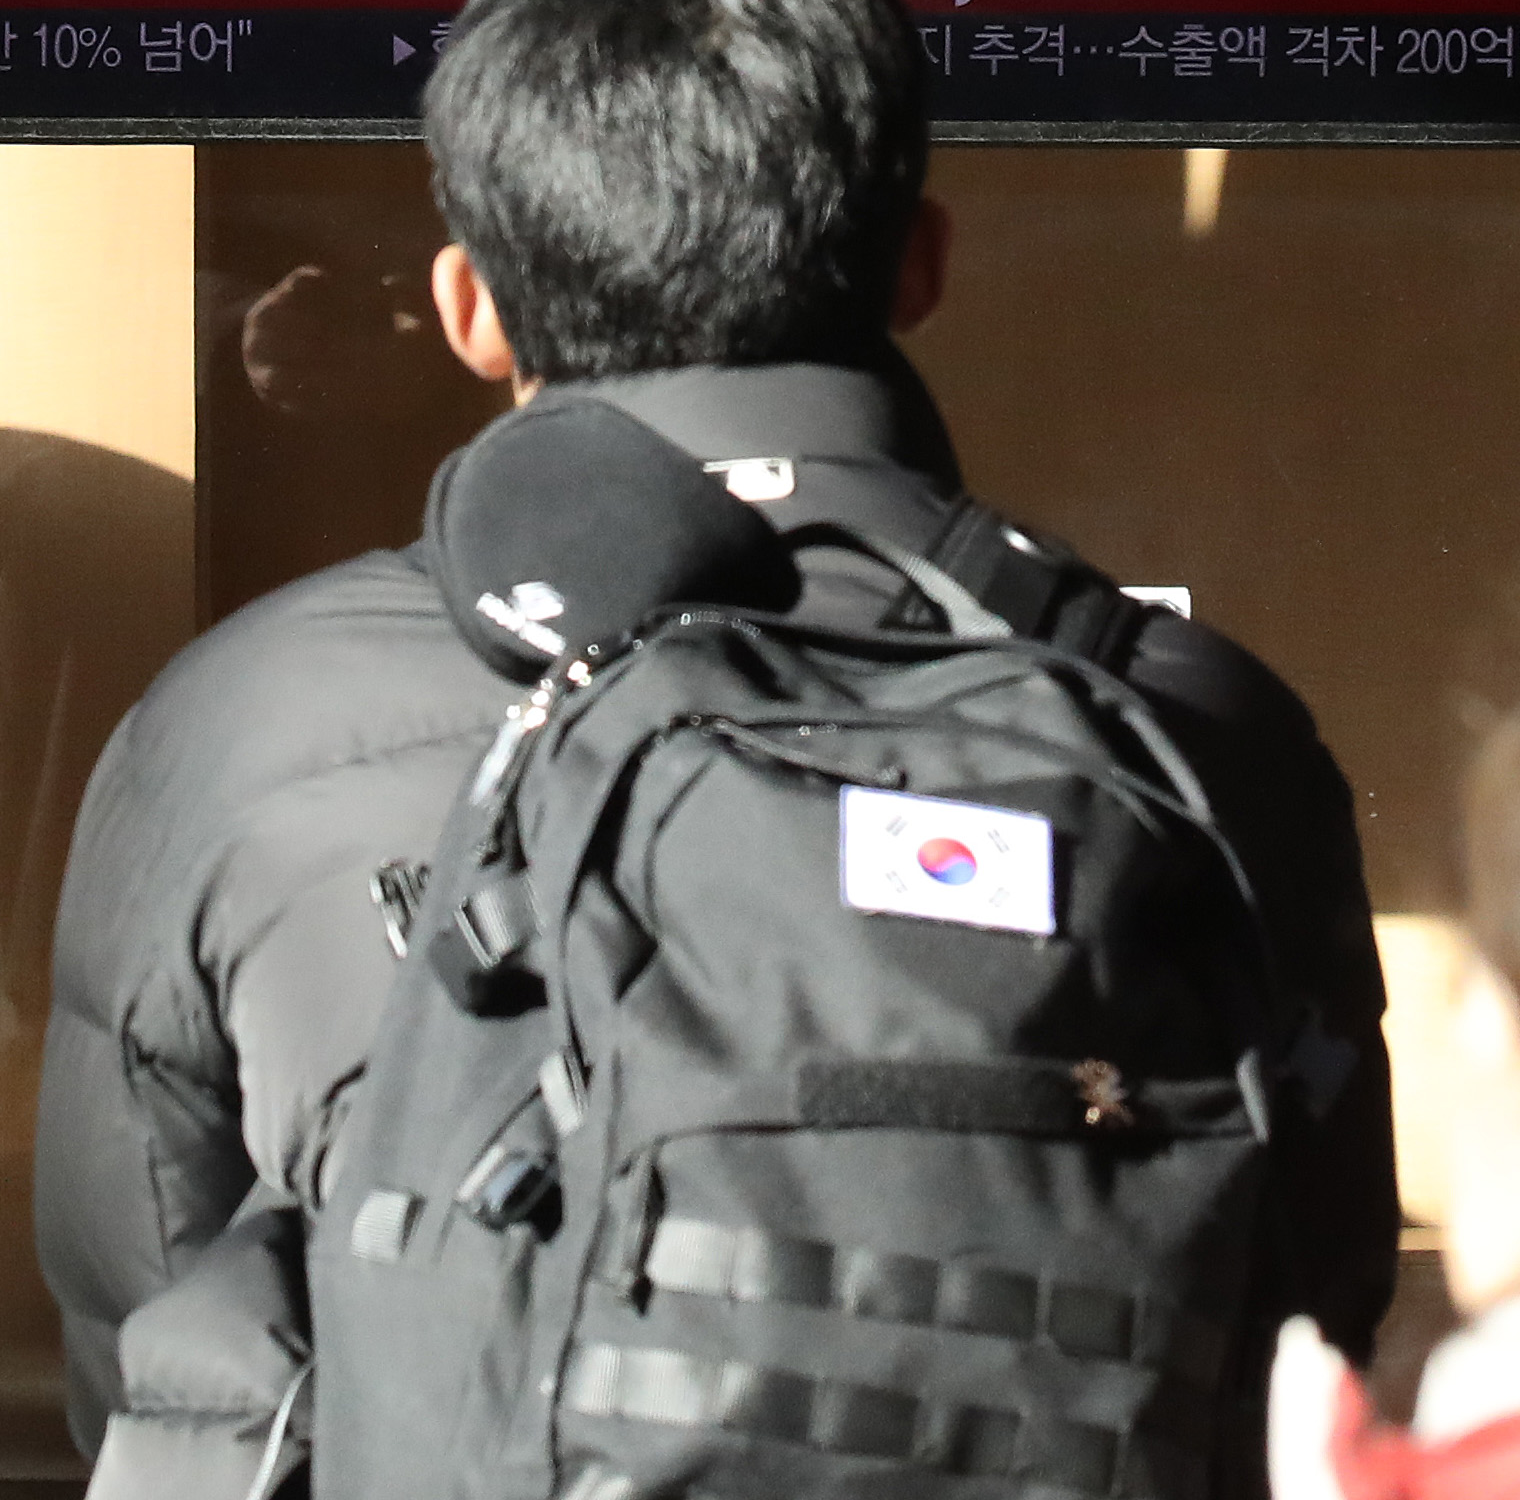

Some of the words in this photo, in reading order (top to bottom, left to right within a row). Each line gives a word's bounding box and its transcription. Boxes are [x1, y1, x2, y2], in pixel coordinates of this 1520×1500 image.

[33, 23, 121, 68] 10%
[139, 19, 253, 73] 넘어"
[1285, 26, 1384, 77] 격차
